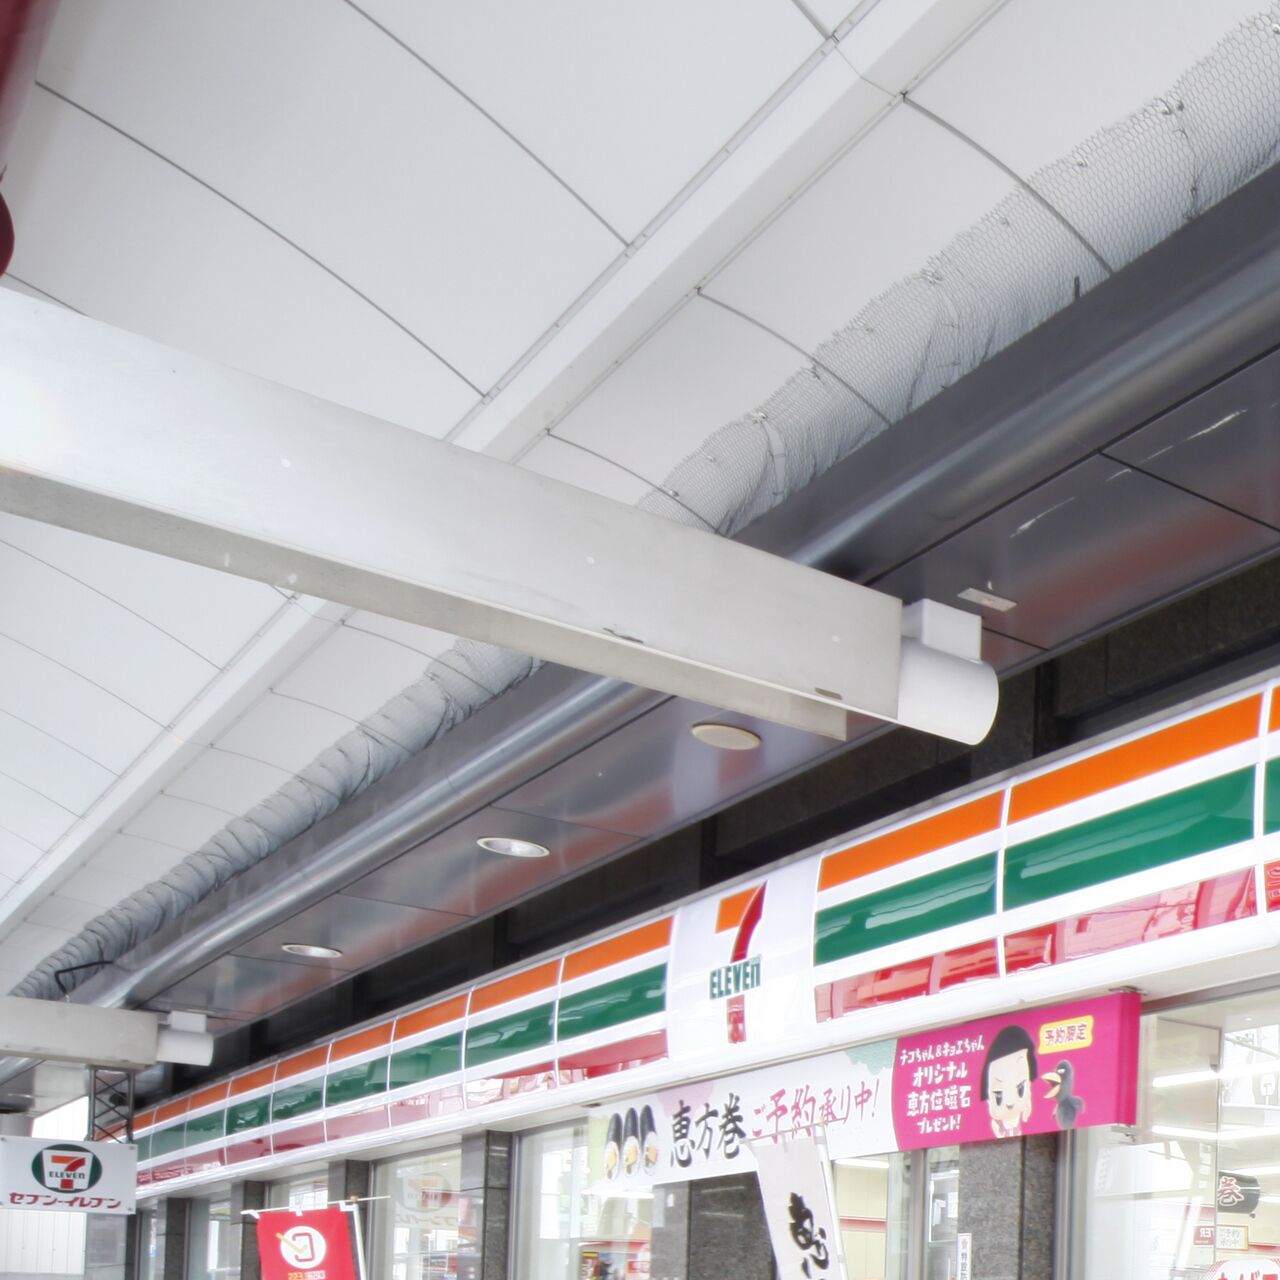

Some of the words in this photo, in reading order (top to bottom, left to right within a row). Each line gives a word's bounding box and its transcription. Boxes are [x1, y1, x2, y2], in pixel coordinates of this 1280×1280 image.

[1045, 1023, 1087, 1046] 予約限定
[913, 1061, 968, 1087] オリジナル
[907, 1085, 972, 1117] 恵方位磁石
